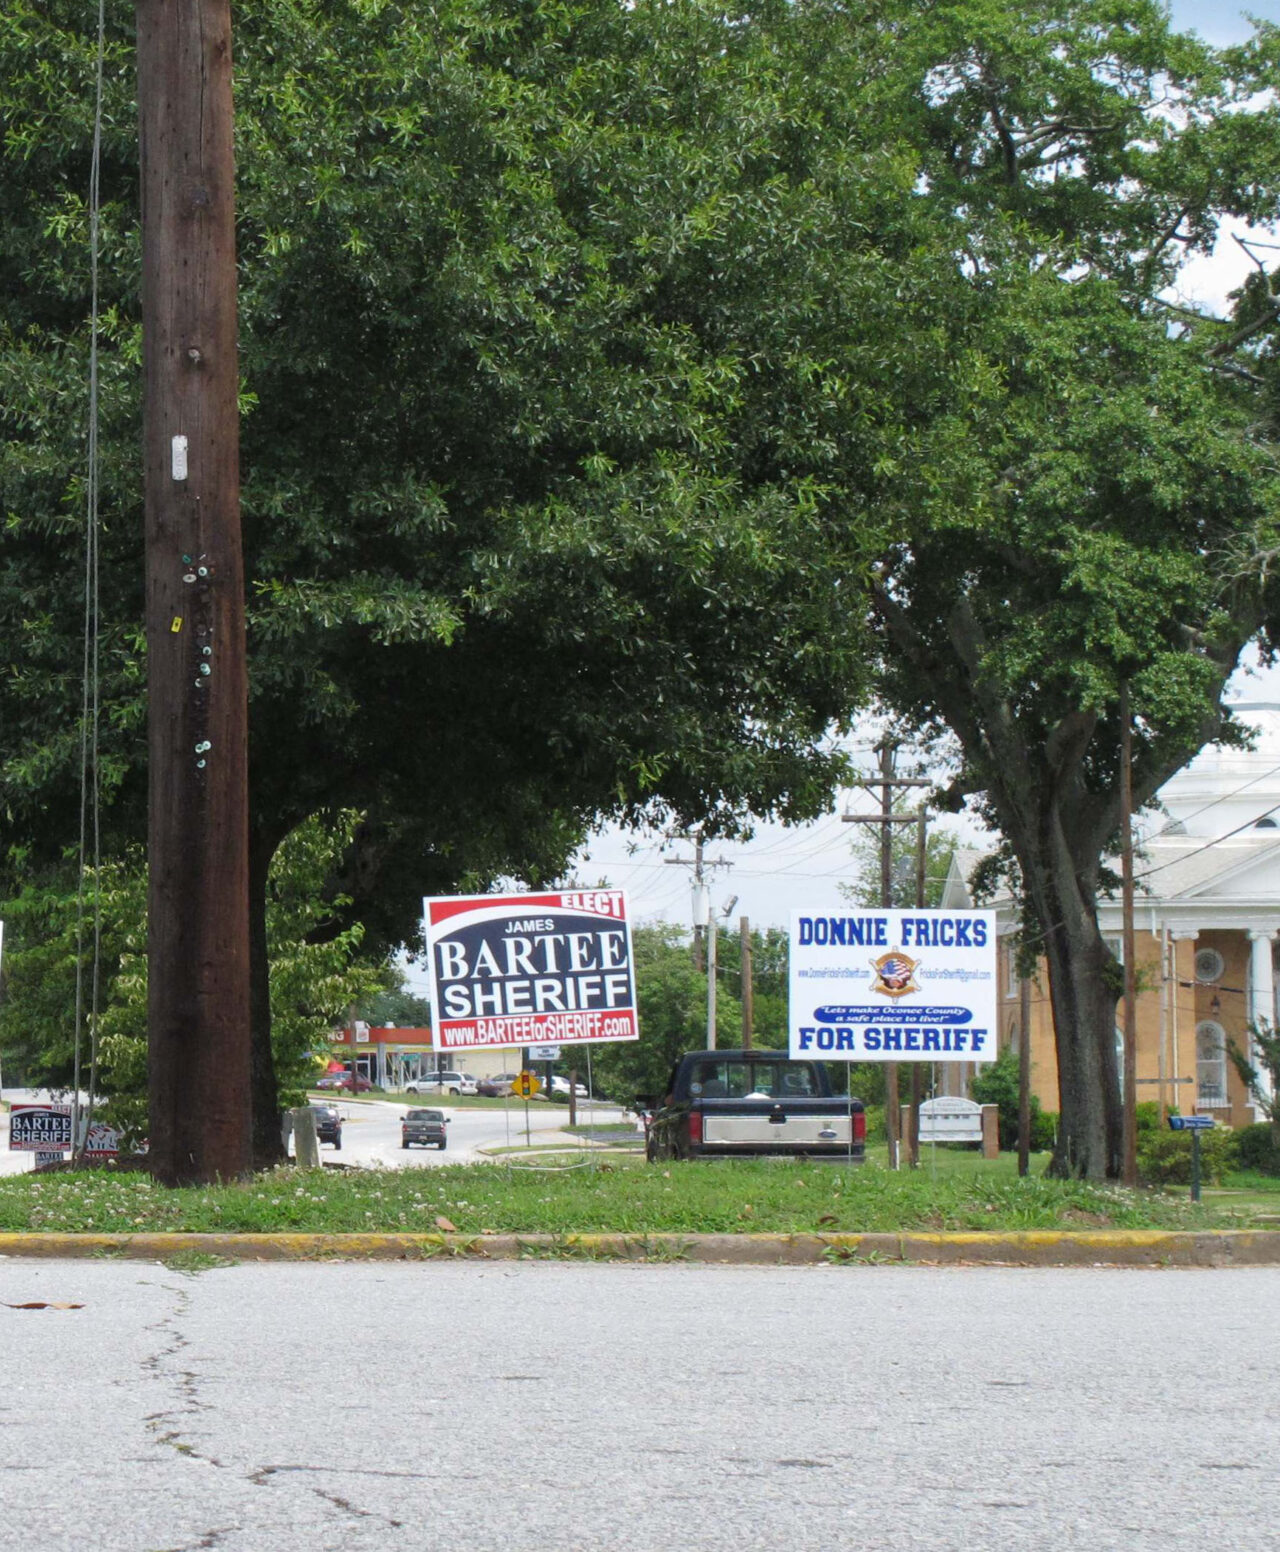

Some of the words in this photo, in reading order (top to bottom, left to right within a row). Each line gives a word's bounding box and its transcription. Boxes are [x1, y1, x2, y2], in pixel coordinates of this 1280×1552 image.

[560, 892, 623, 917] ELECT
[505, 918, 555, 934] JAMES
[799, 917, 887, 946] DONNIE
[901, 918, 987, 947] FRICKS
[436, 930, 628, 981] BARTEE
[444, 974, 628, 1018] SHERIFF
[872, 1015, 903, 1023] place
[882, 1006, 921, 1014] Oconee
[925, 1007, 966, 1016] County
[444, 1014, 631, 1046] www.BARTEEforSHERIFF.com
[799, 1027, 855, 1050] FOR
[863, 1027, 988, 1051] SHERIFF
[12, 1117, 71, 1130] BARTEE
[12, 1131, 70, 1142] SHERIFF
